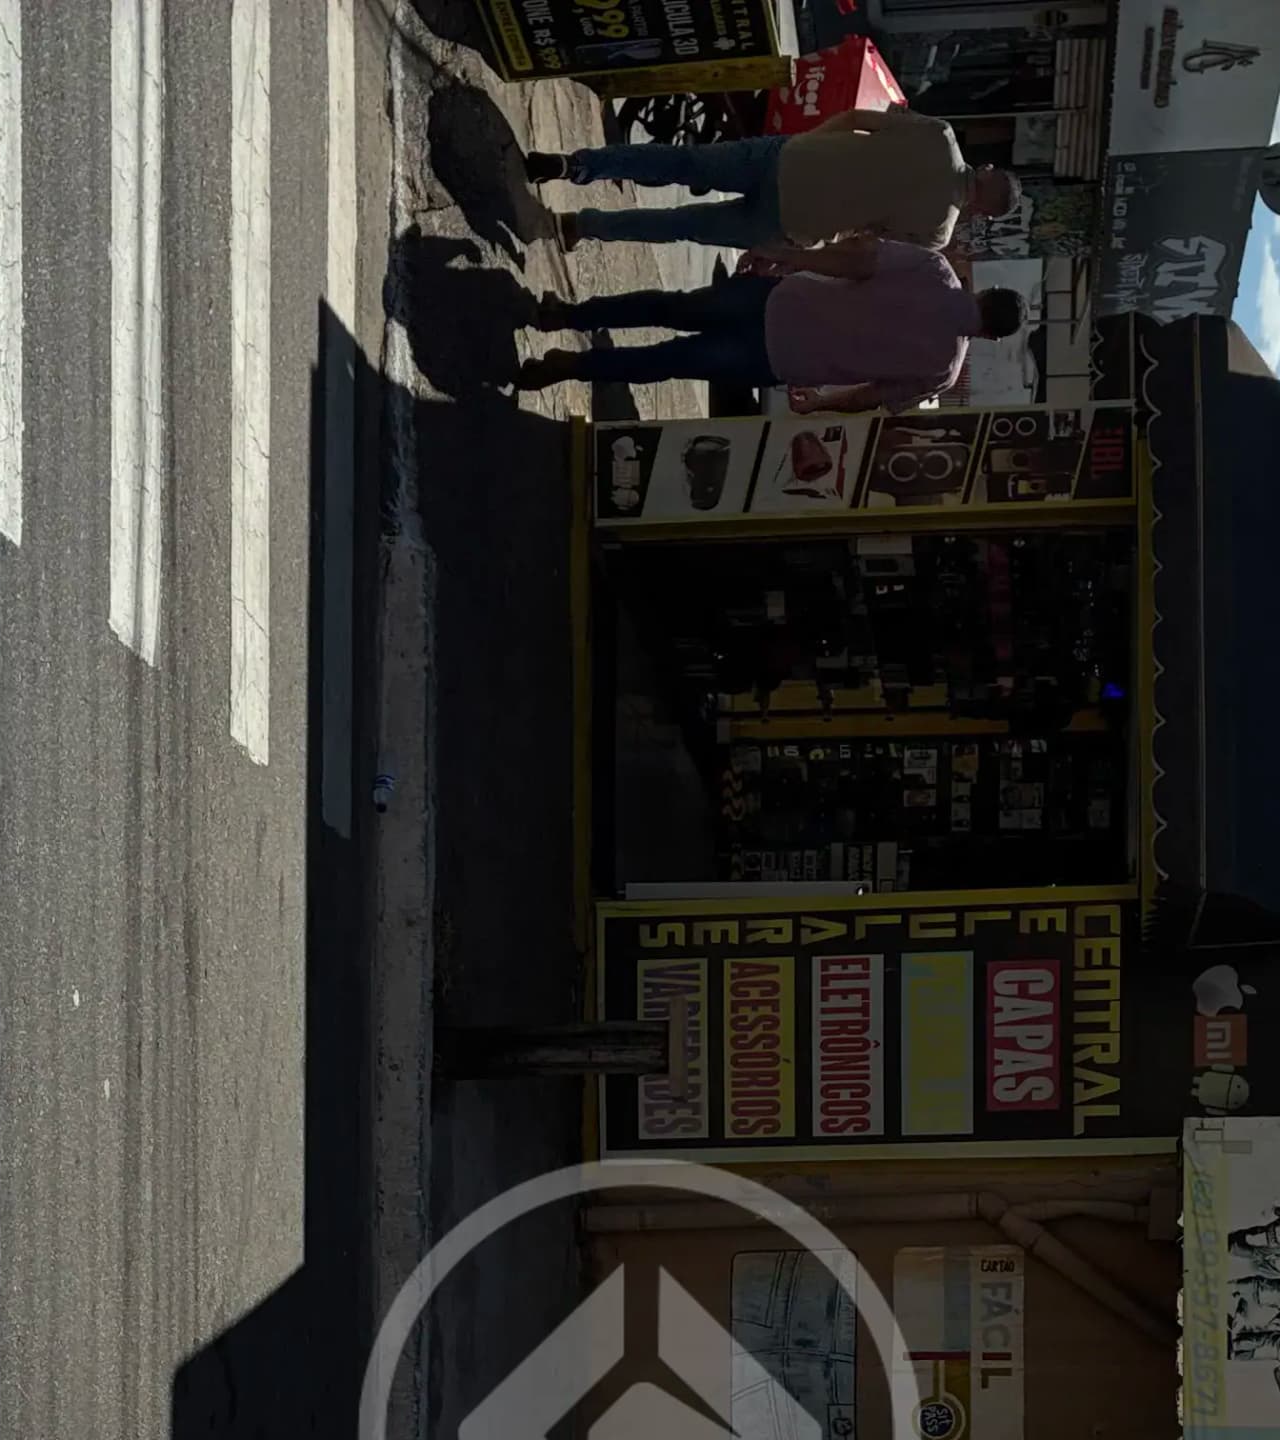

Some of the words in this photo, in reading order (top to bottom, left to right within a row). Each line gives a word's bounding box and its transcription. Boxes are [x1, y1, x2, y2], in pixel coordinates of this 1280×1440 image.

[660, 0, 696, 37] ICULA
[642, 962, 703, 1135] VARDES
[727, 961, 790, 1136] ACESSÓRIOS
[817, 957, 881, 1135] ELETRÔNICOS
[992, 967, 1056, 1104] CAPAS
[1072, 905, 1121, 1136] CENTRAL
[980, 1281, 1020, 1390] FÁCIL
